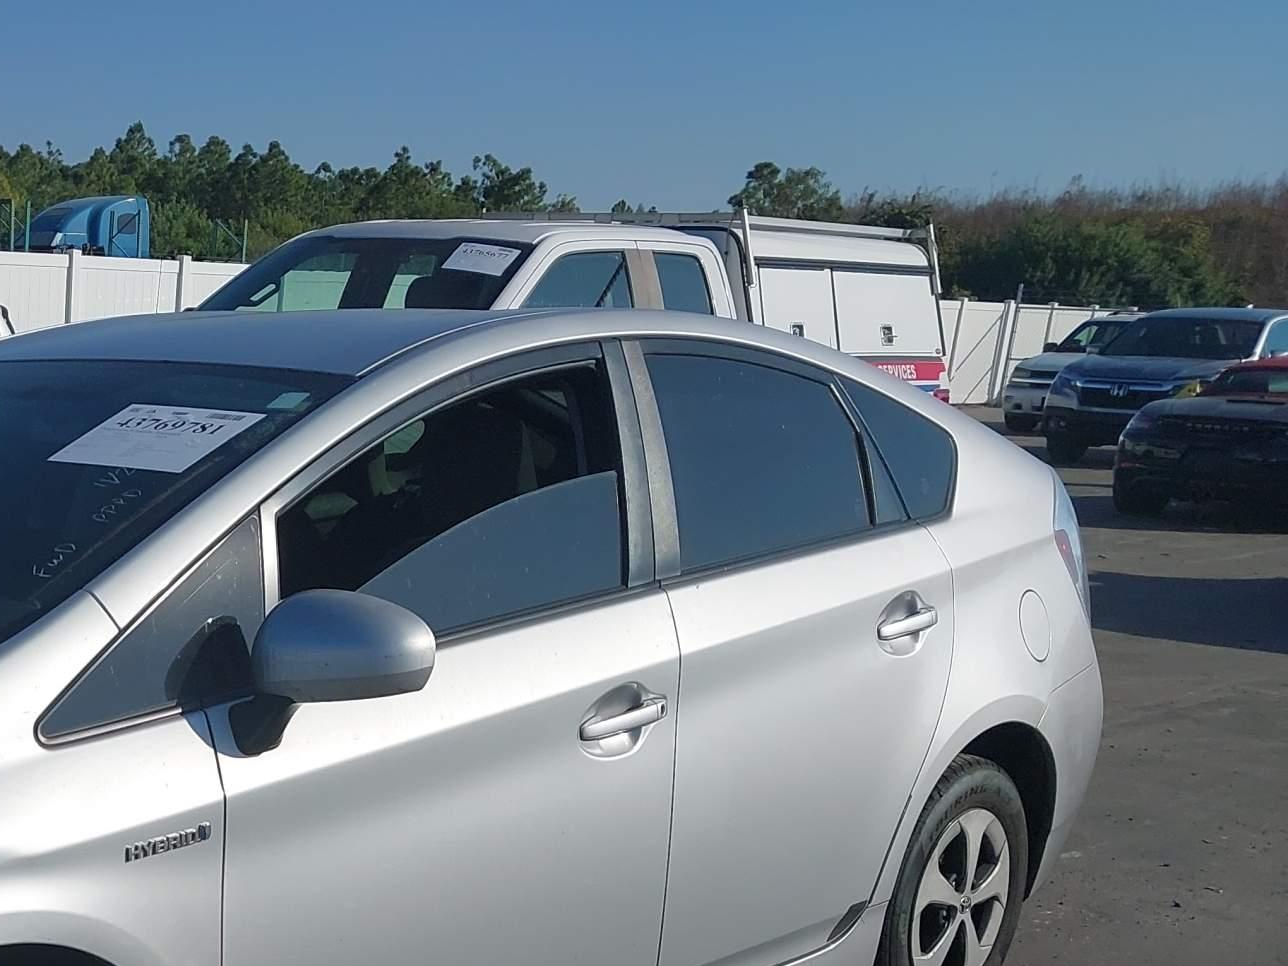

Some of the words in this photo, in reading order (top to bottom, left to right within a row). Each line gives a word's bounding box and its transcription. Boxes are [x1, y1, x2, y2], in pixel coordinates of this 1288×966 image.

[878, 364, 917, 380] ERVICES
[116, 416, 227, 435] 43769781
[124, 828, 201, 864] HYBRID
